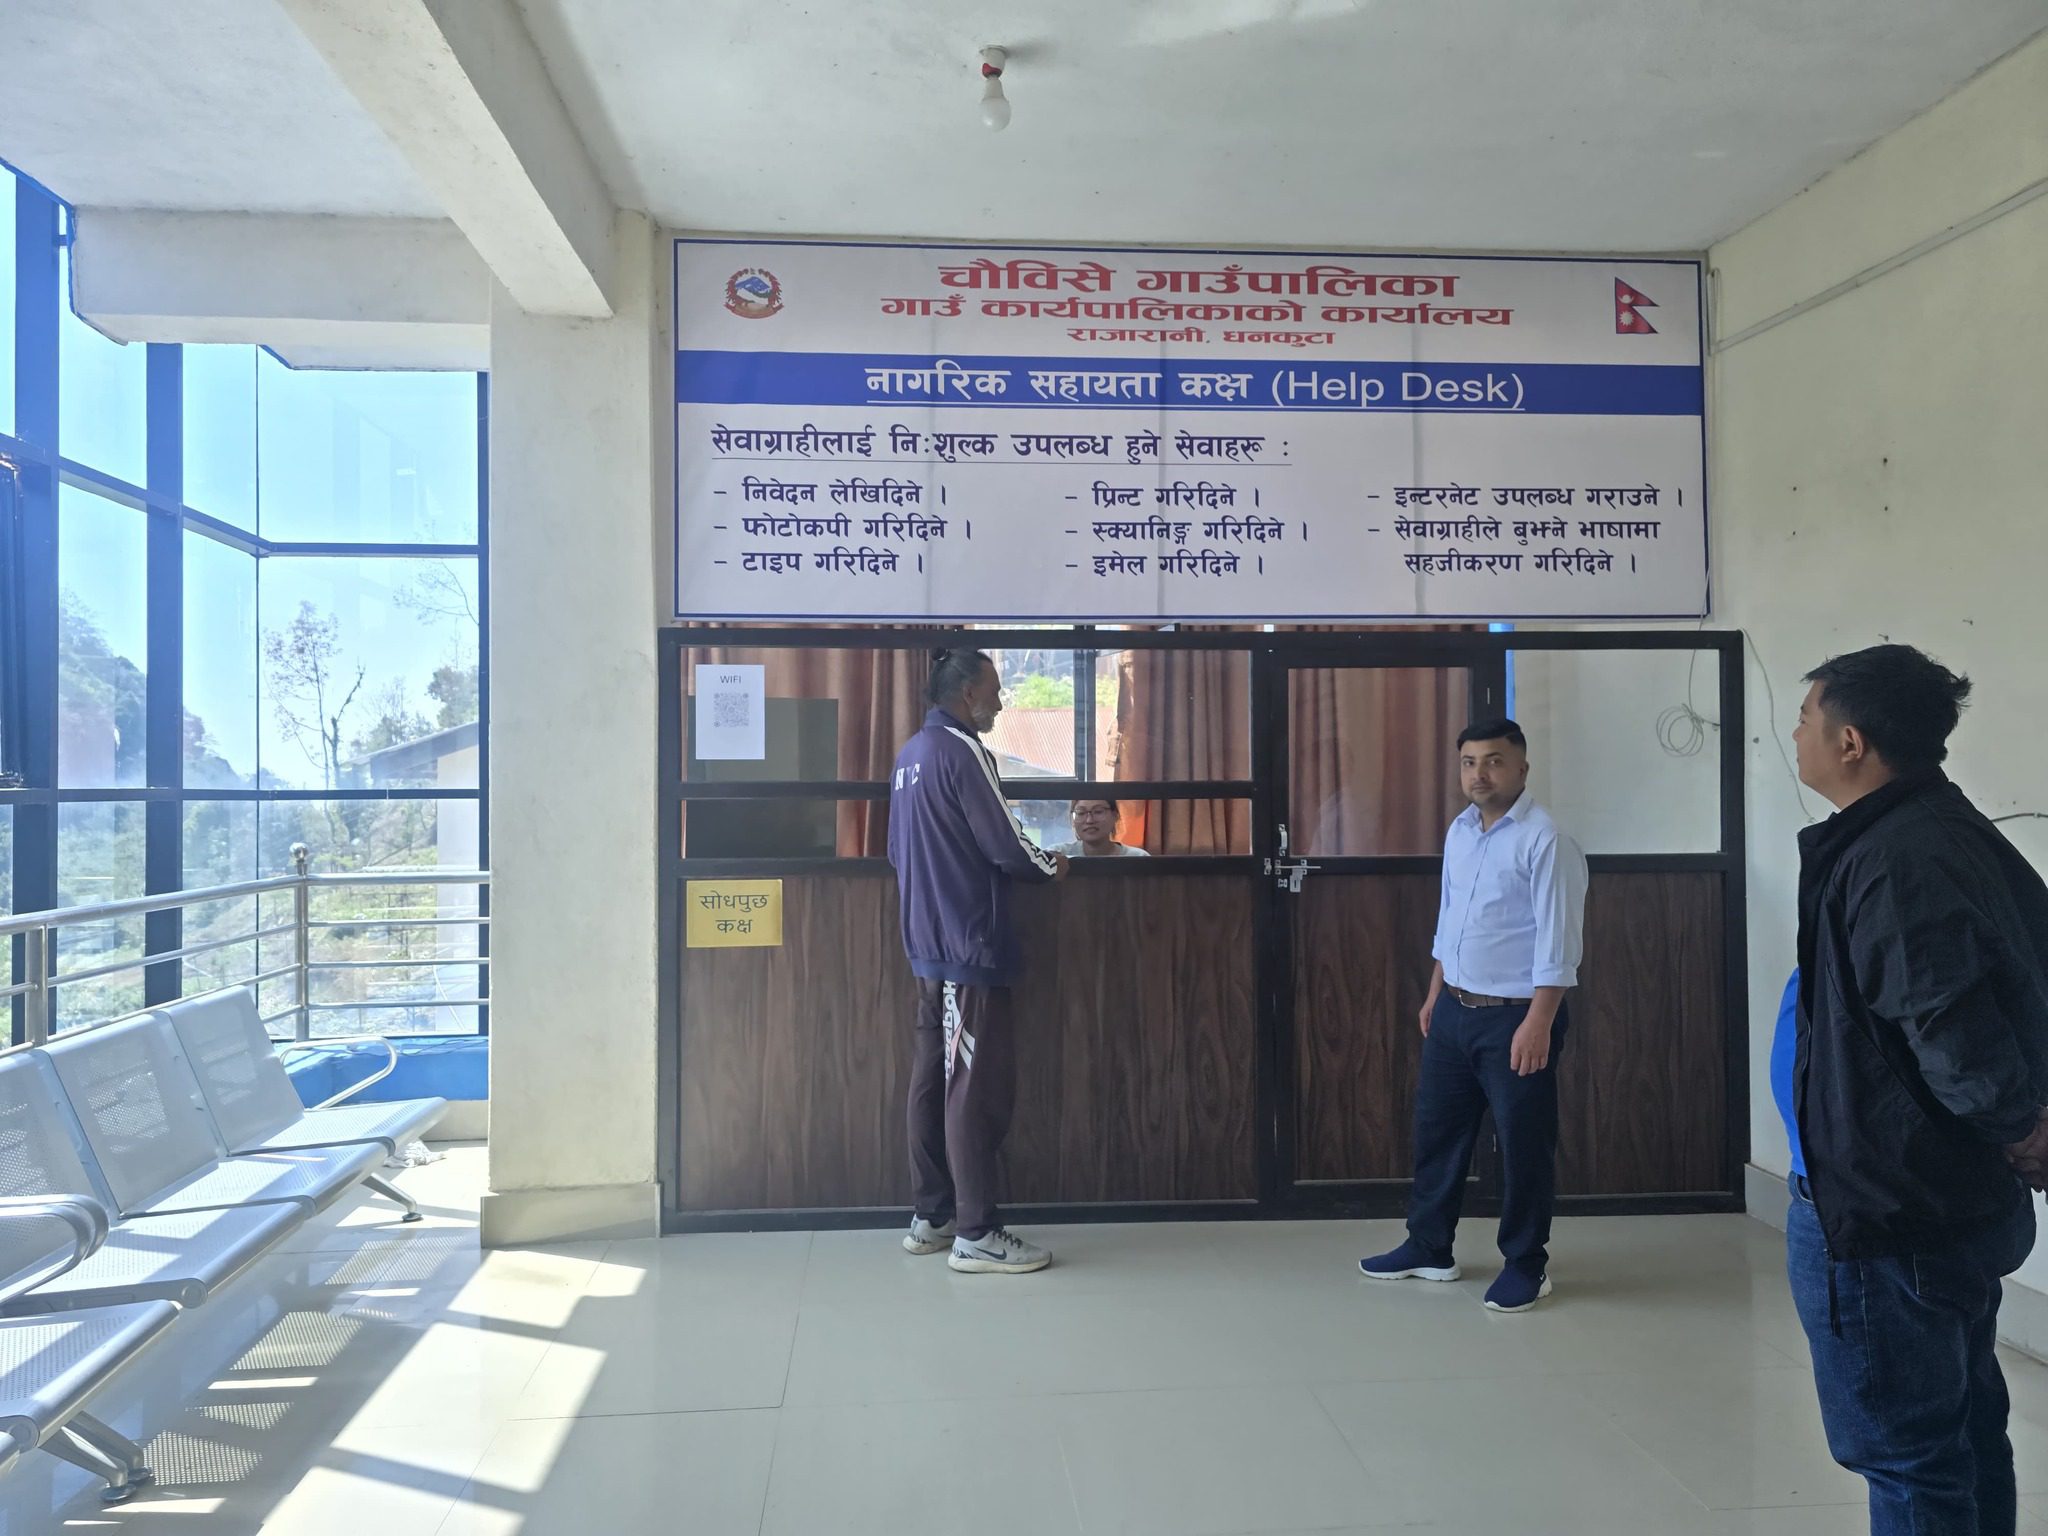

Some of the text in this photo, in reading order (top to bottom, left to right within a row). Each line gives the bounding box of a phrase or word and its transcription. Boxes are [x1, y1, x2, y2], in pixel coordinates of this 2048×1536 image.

[938, 259, 1459, 298] चौविसे गाउँपालिका
[881, 295, 1514, 326] गाउँ कार्यपालिकाको कार्यालय
[1223, 330, 1335, 348] धनकुटा
[864, 360, 1525, 410] नागरिक सहायता कक्ष (Help Desk)
[710, 423, 876, 457] सेवाग्राहीलाई
[1010, 434, 1113, 458] उपलब्ध
[1126, 429, 1162, 465] हुने
[1174, 430, 1265, 462] सेवाहरू
[741, 476, 818, 504] निवेदन
[829, 477, 923, 507] लेखिदिने
[1091, 481, 1144, 508] प्रिन्ट
[1155, 482, 1237, 510] गरिदिने
[1394, 482, 1481, 509] इन्टरनेट
[1491, 488, 1575, 507] उपलब्ध
[1585, 483, 1660, 509] गराउने
[742, 512, 852, 537] फोटोकपी
[863, 512, 948, 542] गरिदिने
[1203, 515, 1285, 544] गरिदिने
[1394, 515, 1502, 542] सेवाग्राहीले
[1578, 522, 1661, 539] भाषामा
[741, 553, 803, 574] टाइप
[814, 546, 899, 576] गरिदिने
[1092, 551, 1147, 576] इमेल
[1158, 549, 1240, 578] गरिदिने
[1404, 548, 1523, 576] सहजीकरण
[1533, 548, 1614, 575] गरिदिने
[719, 675, 742, 684] WIFI
[698, 889, 770, 913] सोधपुछ
[714, 919, 753, 934] कक्ष
